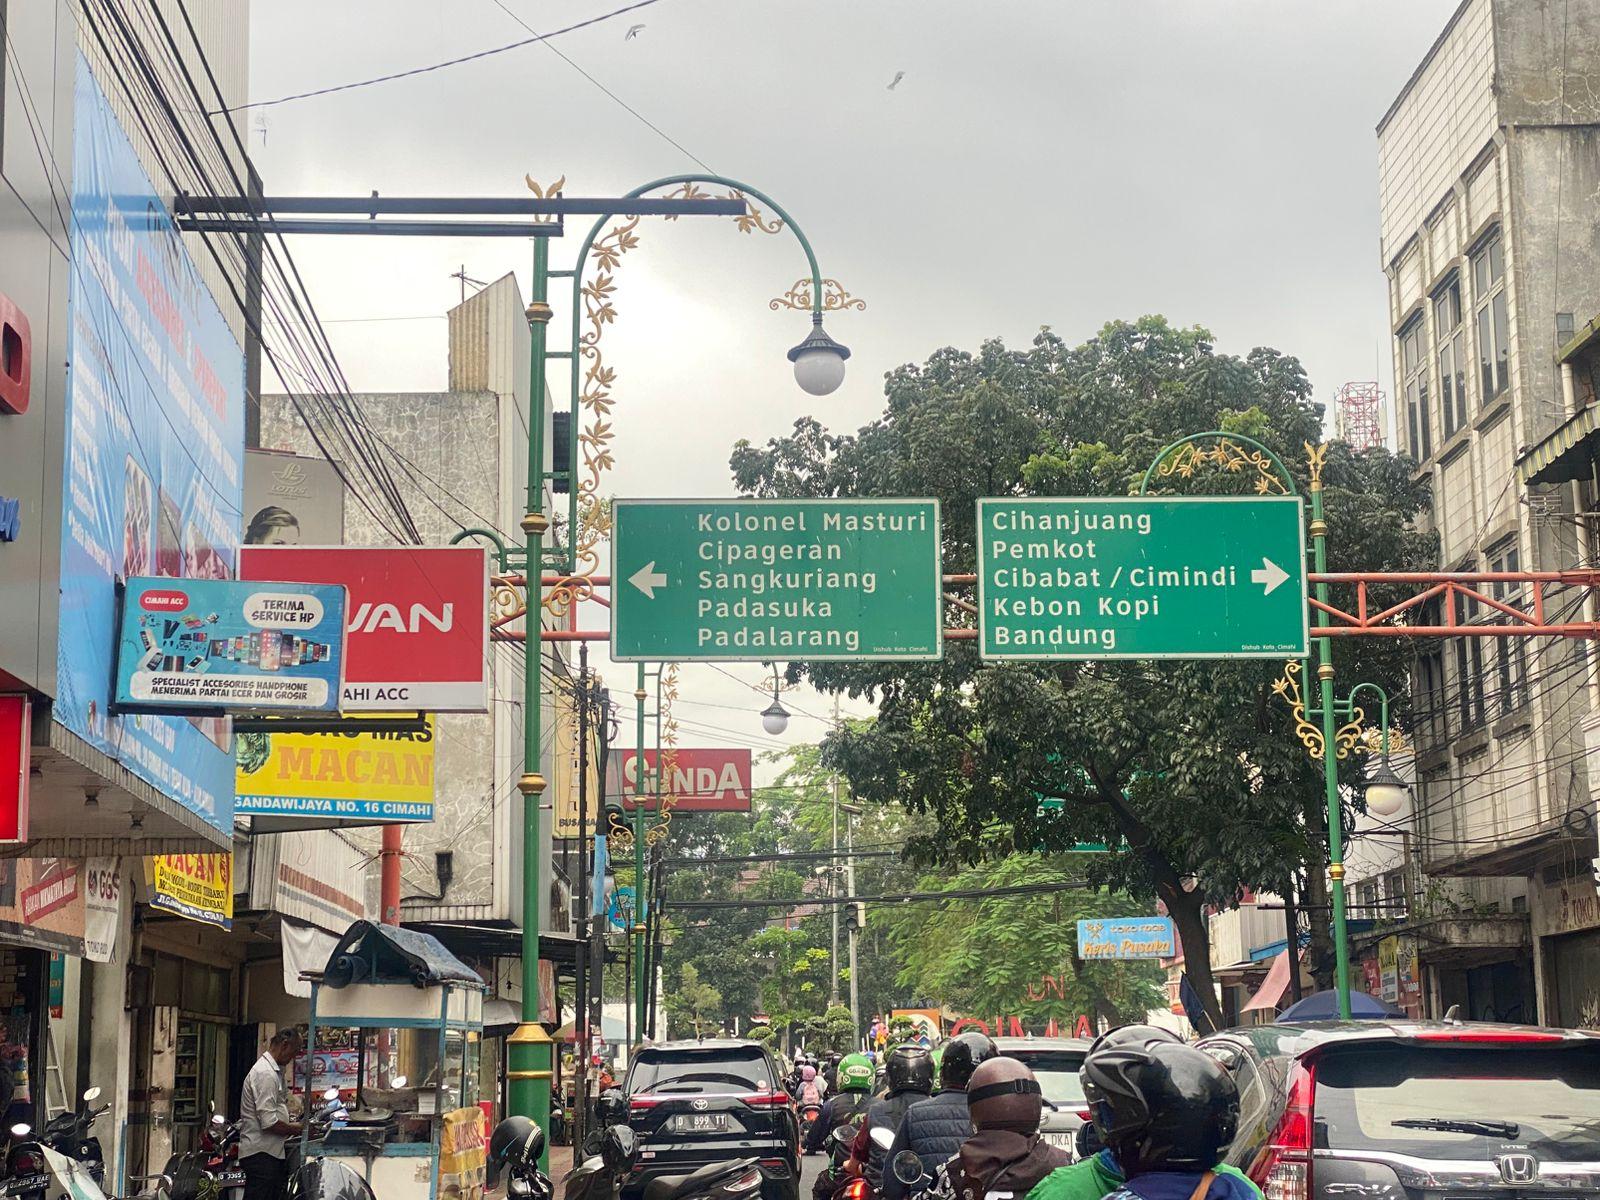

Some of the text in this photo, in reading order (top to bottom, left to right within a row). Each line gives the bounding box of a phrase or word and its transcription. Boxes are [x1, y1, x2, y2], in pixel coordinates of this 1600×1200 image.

[698, 511, 926, 532] Kolonel Masturi
[992, 511, 1152, 535] Cihanjuang
[698, 541, 842, 565] Cipageran
[993, 539, 1097, 559] Pemkot
[699, 569, 877, 594] Sangkuriang
[993, 567, 1101, 588] Cibabat
[1130, 566, 1237, 587] Cimindi
[144, 596, 184, 606] CIMAHI ACC
[263, 599, 305, 611] TERIMA
[698, 598, 833, 618] Padasuka
[994, 595, 1160, 620] Kebon Kopi
[251, 610, 315, 623] SERVICE HP
[698, 626, 860, 651] Padalarang
[994, 625, 1116, 649] Bandung
[151, 687, 308, 700] MENERIMA PARTAI ECER DAN GROSIR
[152, 678, 308, 691] SPECIALIST ACCESORIES HANDPHONE
[375, 688, 409, 701] ACC
[277, 746, 433, 787] MACAN
[234, 796, 431, 816] GANDAWIJAYA NO. 16 CIMAHI
[1572, 896, 1593, 926] TOKO
[678, 1116, 725, 1126] D 899 TT
[1051, 1134, 1070, 1146] DKA
